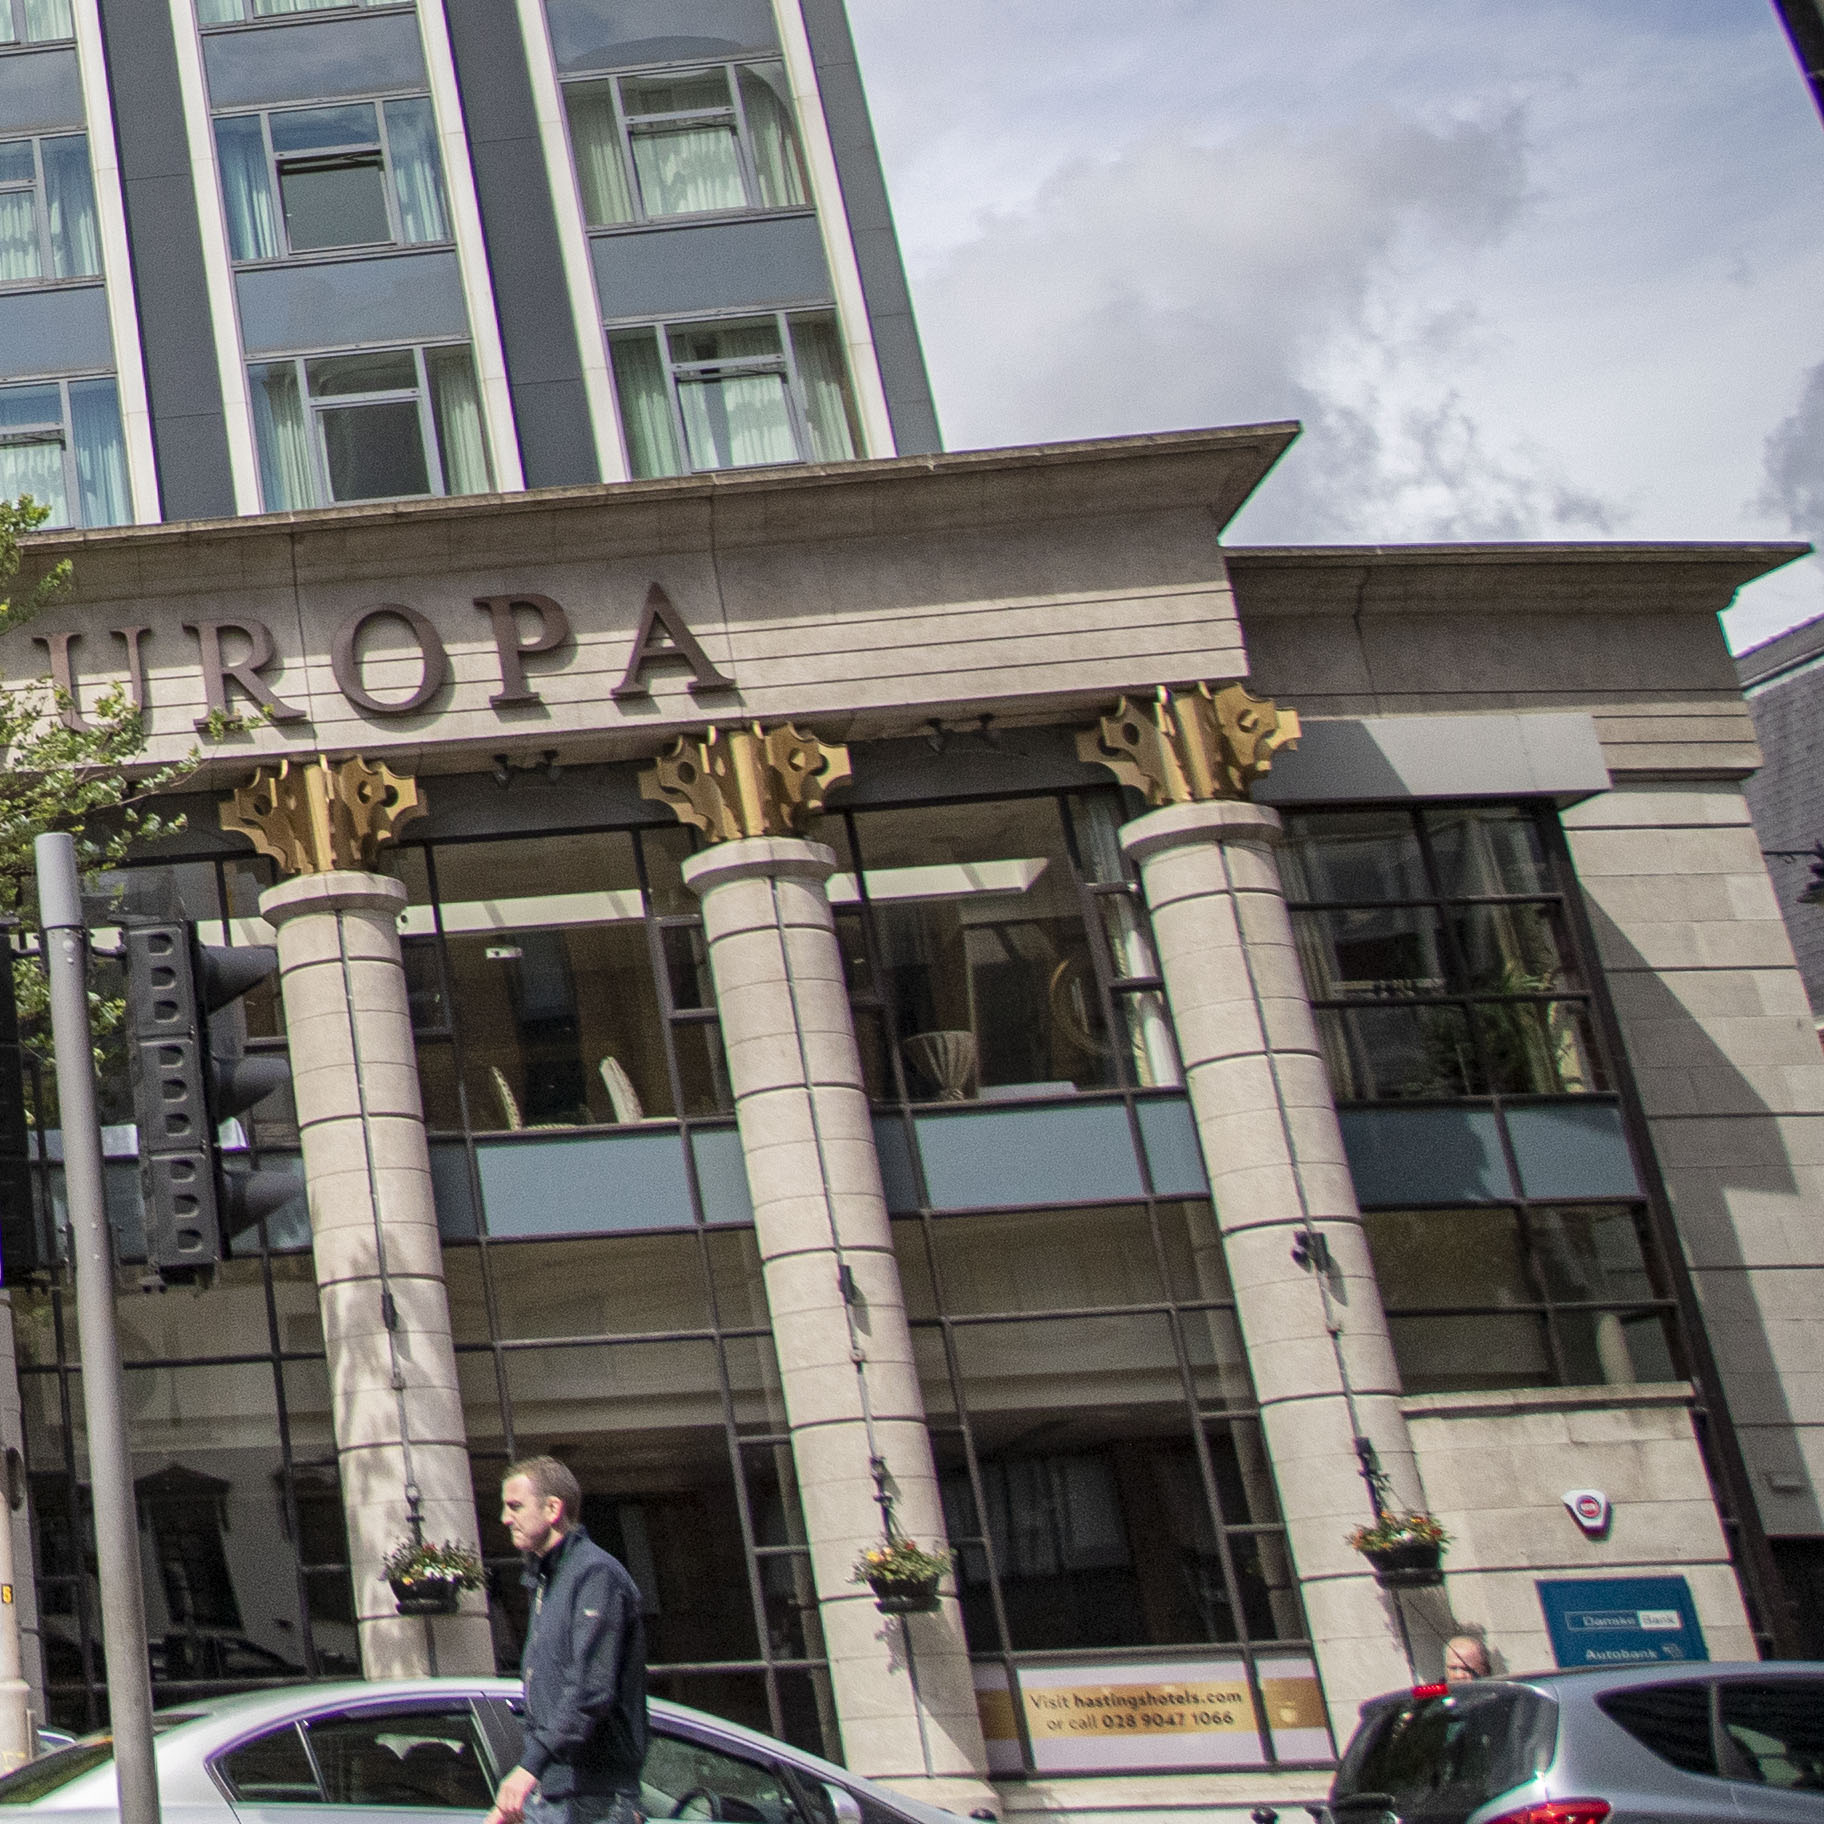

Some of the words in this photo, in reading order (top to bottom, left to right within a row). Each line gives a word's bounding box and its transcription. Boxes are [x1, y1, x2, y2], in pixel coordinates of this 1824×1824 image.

[1582, 1614, 1636, 1627] Danske
[1641, 1614, 1677, 1626] Bank
[1585, 1647, 1658, 1661] Autobank
[1028, 1694, 1070, 1710] Visit
[1072, 1690, 1243, 1713] hastingshotels.com
[1047, 1718, 1064, 1730] or
[1067, 1715, 1098, 1730] call
[1102, 1714, 1136, 1728] 028
[1140, 1712, 1186, 1727] 9047
[1192, 1710, 1234, 1726] 1066
